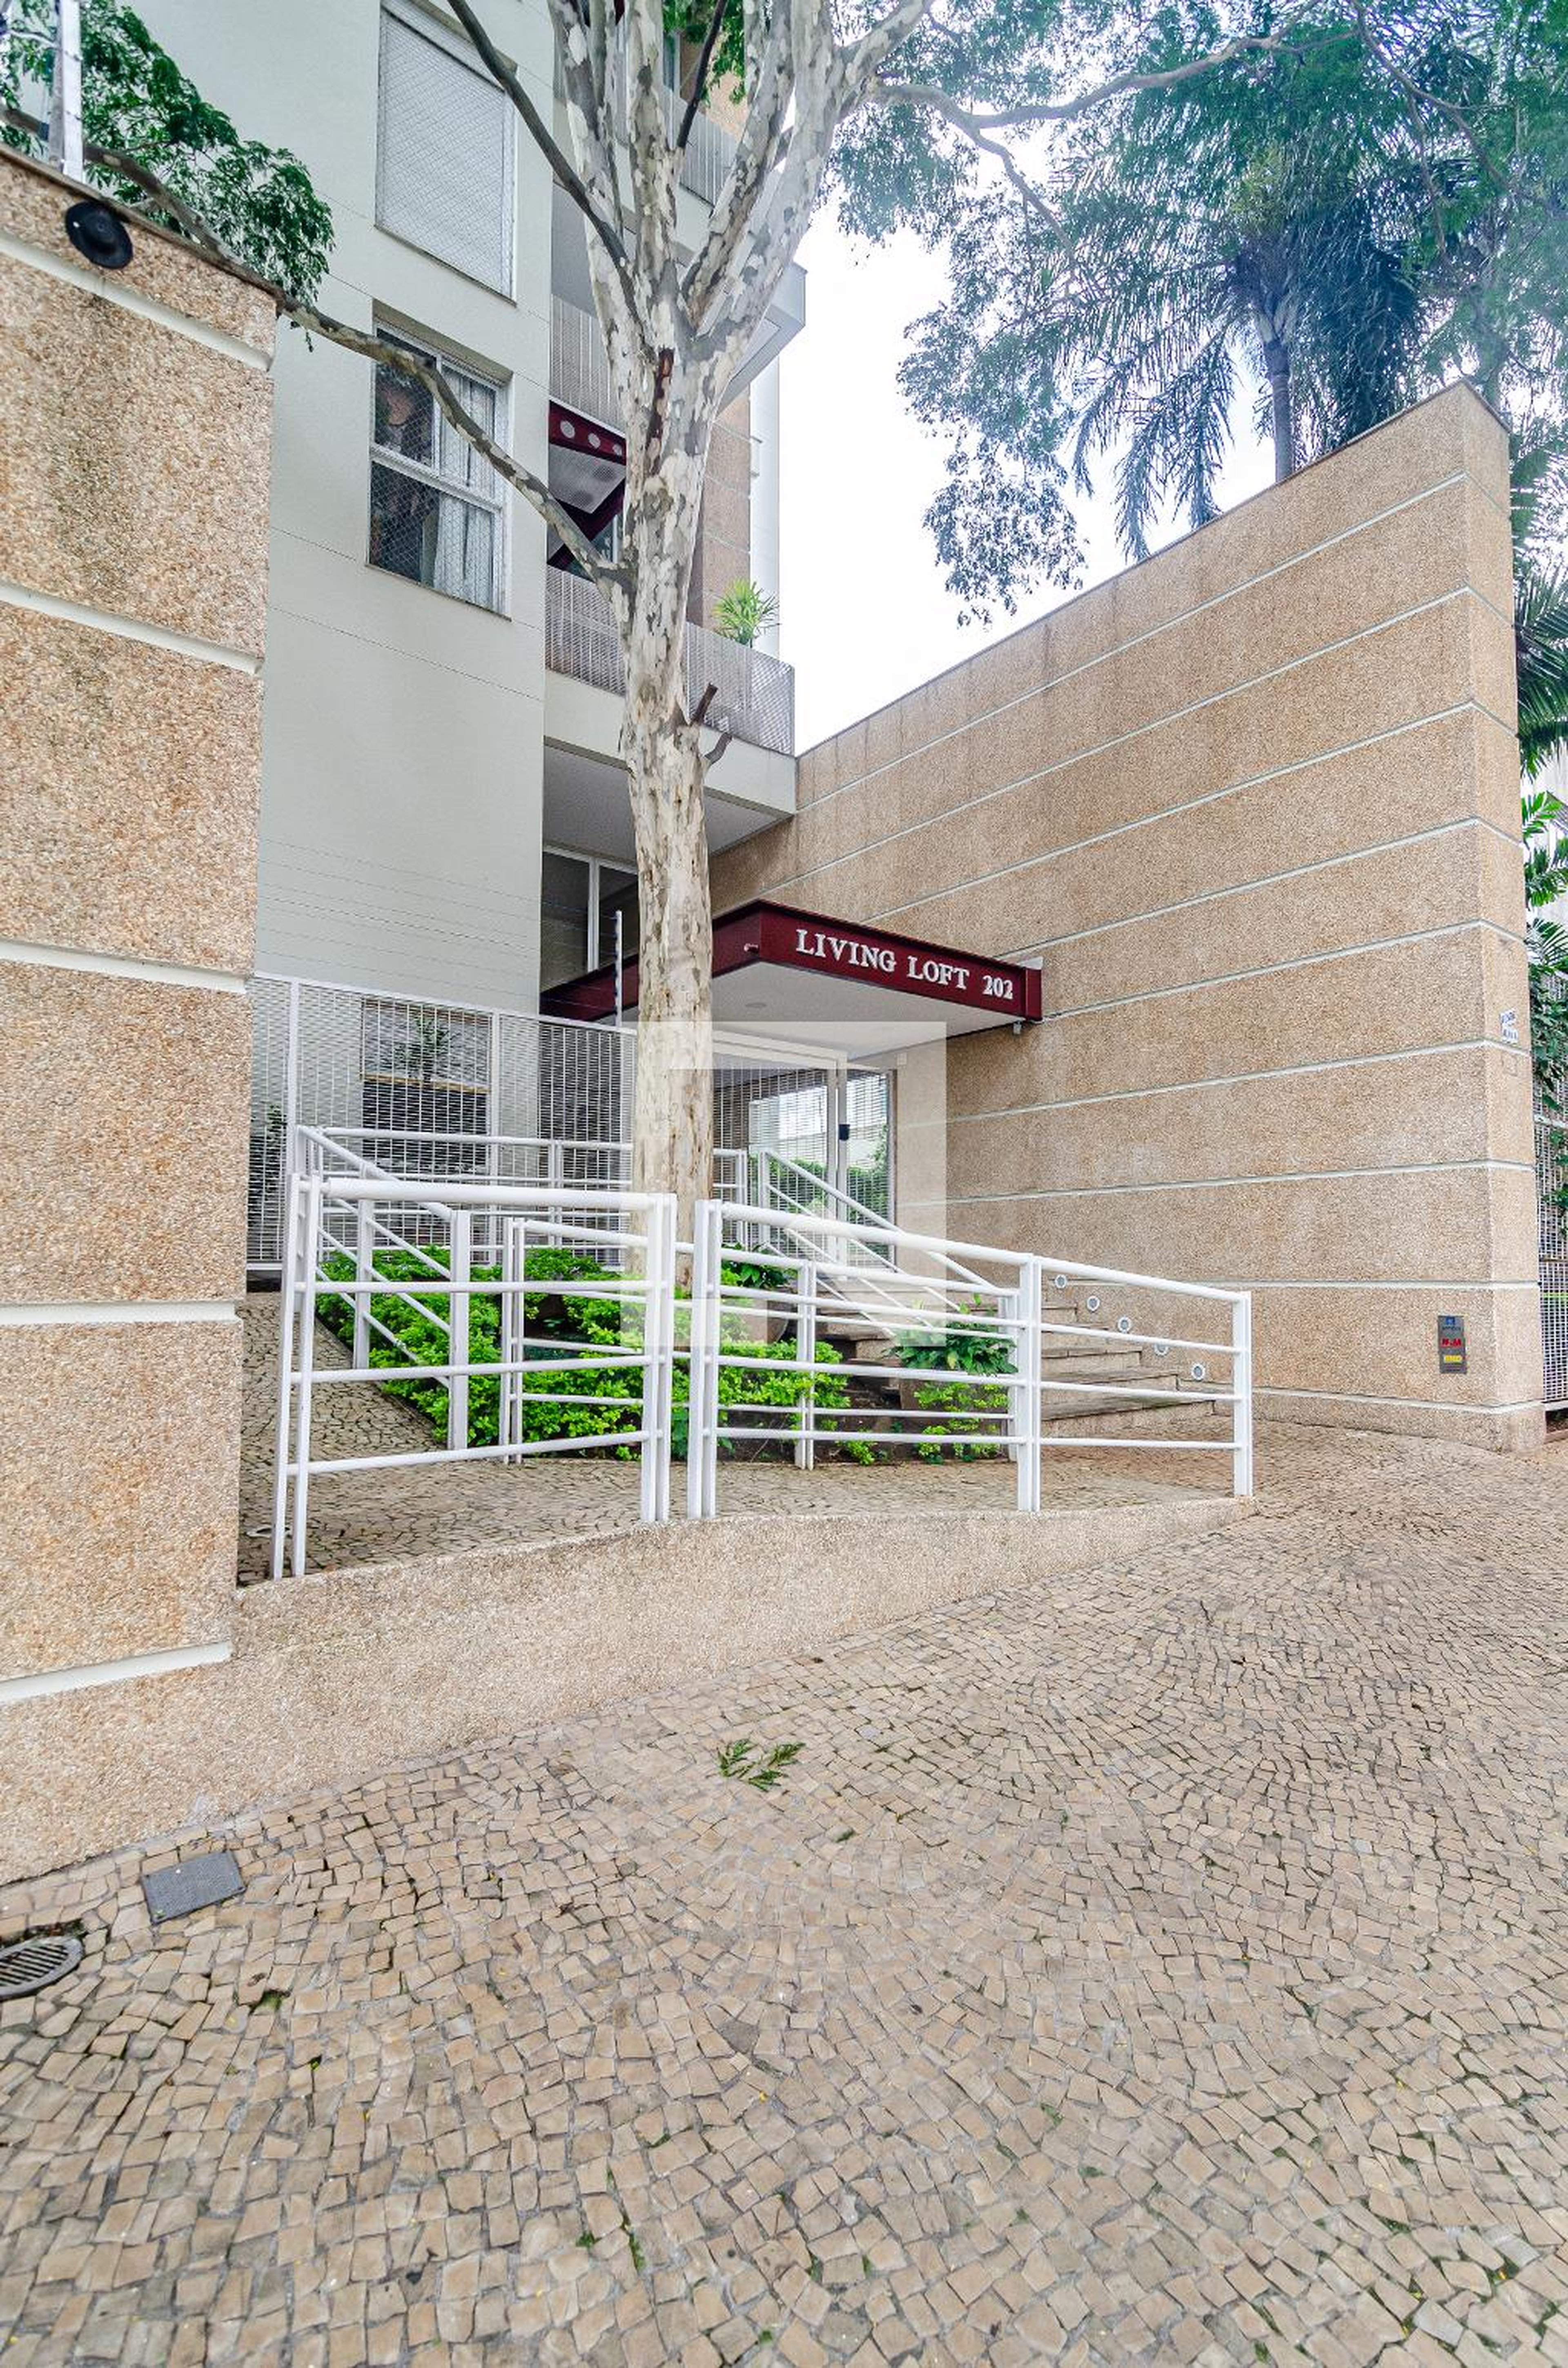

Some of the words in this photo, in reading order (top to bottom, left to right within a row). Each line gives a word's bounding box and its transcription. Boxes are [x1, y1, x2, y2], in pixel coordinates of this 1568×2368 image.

[795, 929, 897, 972] LIVING
[907, 955, 970, 990] LOFT
[982, 974, 1013, 1000] 202
